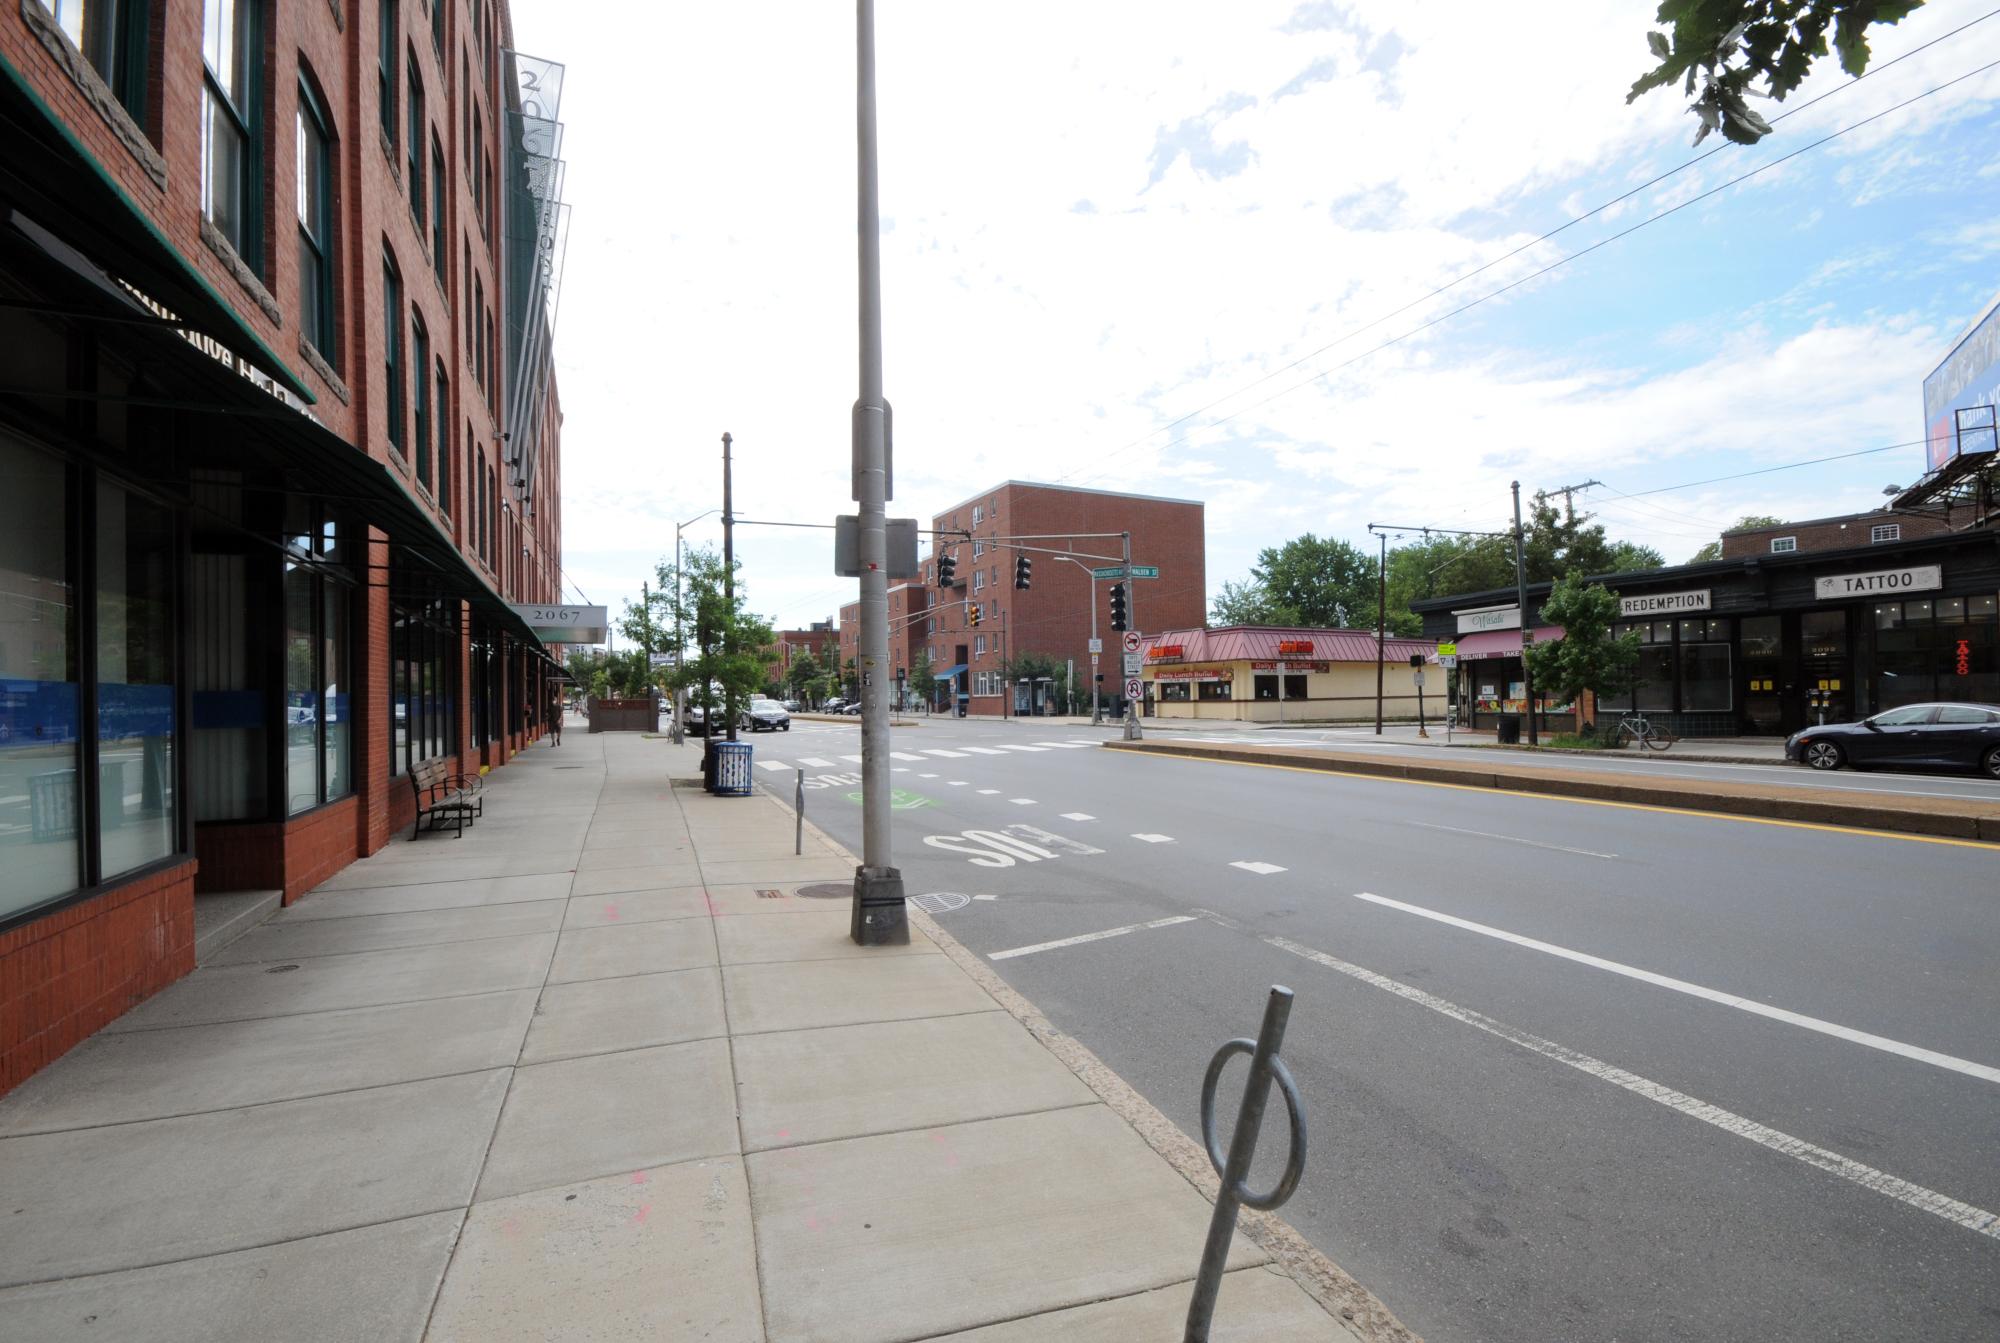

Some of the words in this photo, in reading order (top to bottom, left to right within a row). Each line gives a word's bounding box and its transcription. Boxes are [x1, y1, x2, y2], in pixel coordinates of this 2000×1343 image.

[1844, 573, 1912, 592] TATTOO
[1625, 594, 1705, 612] REDEMPTION
[534, 608, 580, 623] 2067
